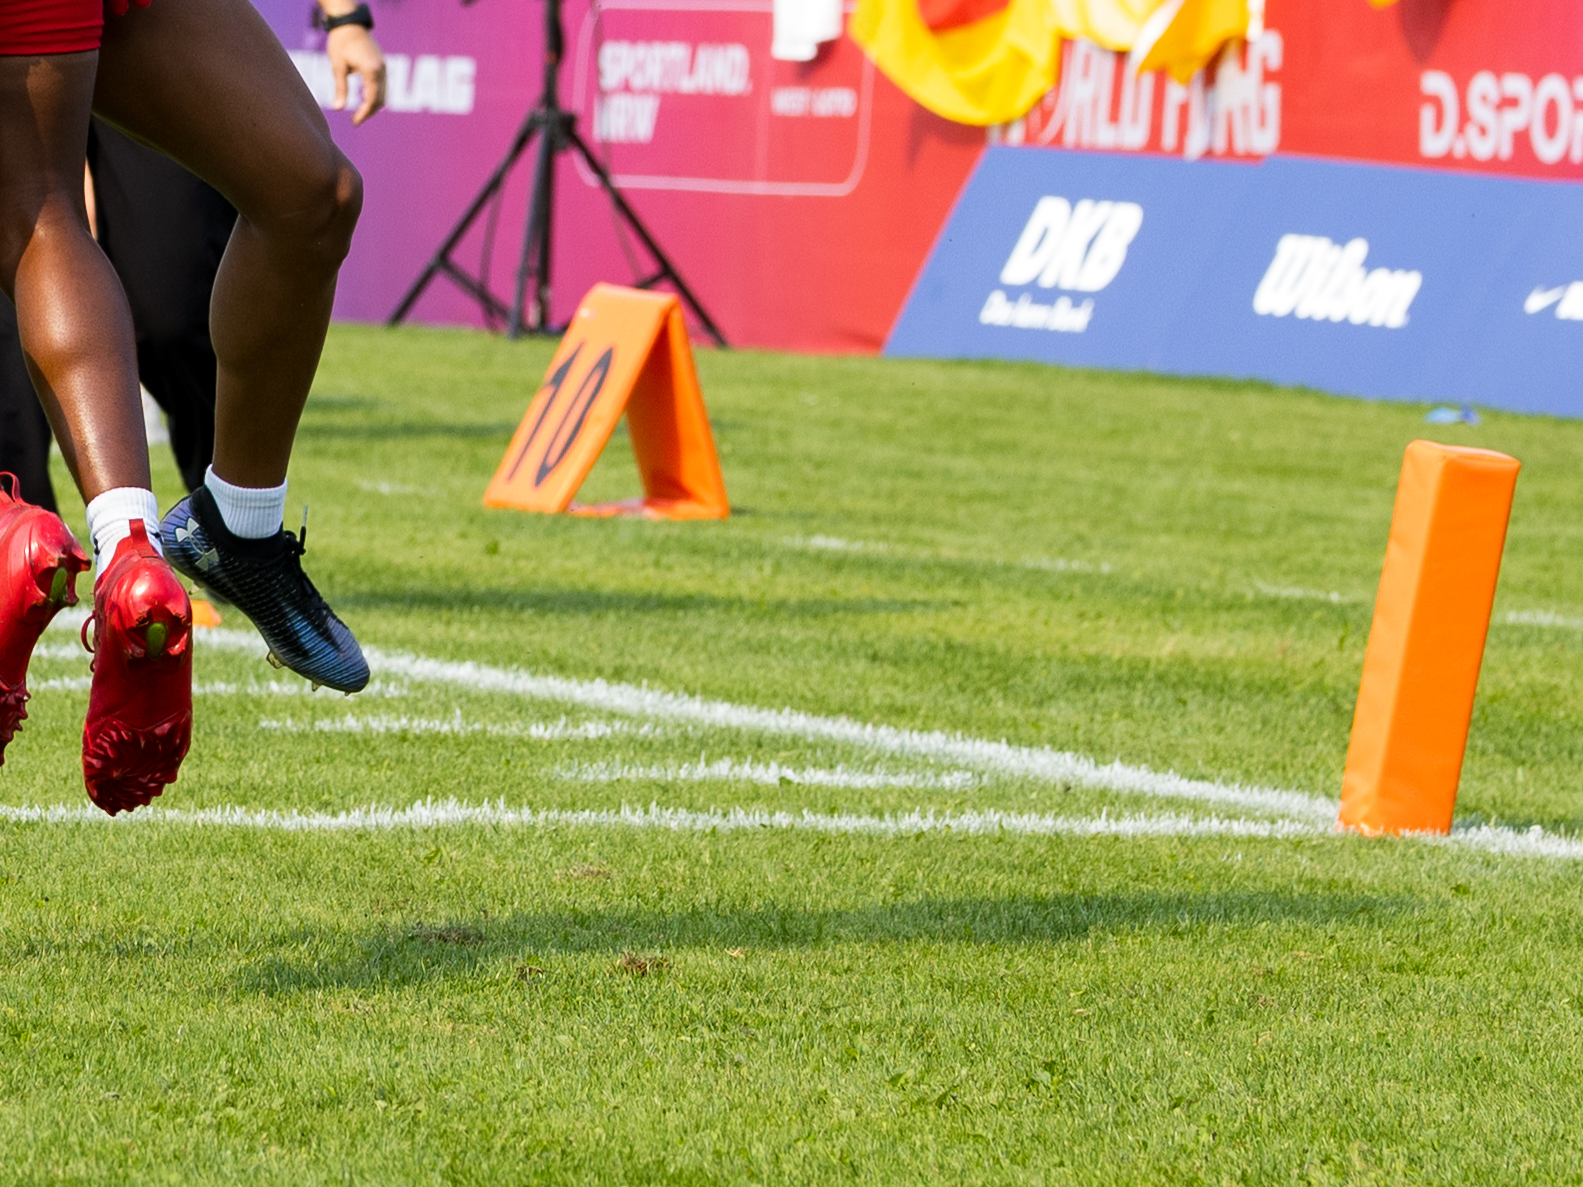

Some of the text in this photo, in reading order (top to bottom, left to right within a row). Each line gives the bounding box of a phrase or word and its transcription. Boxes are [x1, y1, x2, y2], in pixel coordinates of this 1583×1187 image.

[999, 195, 1144, 292] DKB
[1252, 233, 1422, 329] Wilson
[507, 340, 614, 488] 10
